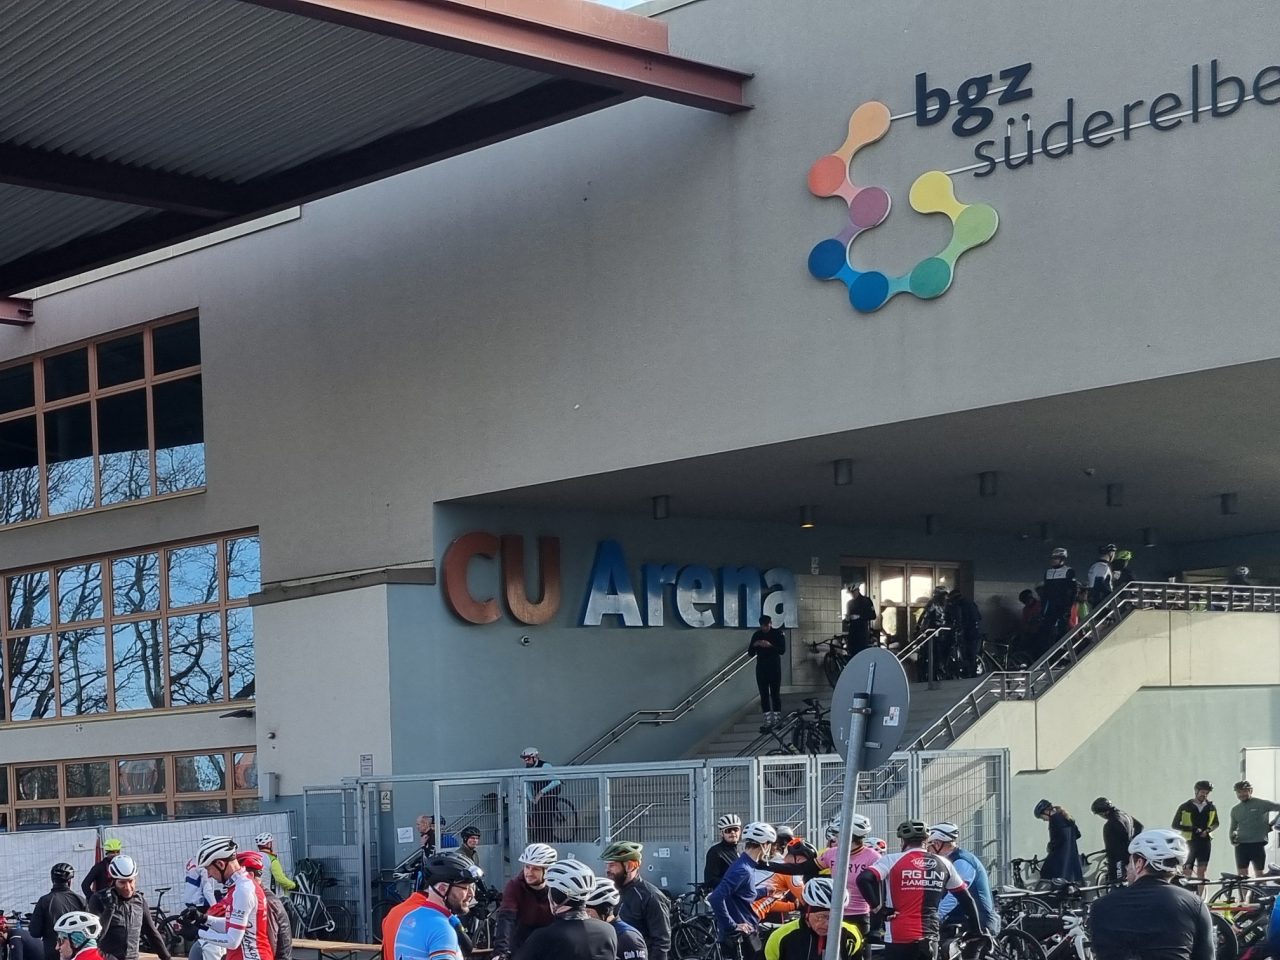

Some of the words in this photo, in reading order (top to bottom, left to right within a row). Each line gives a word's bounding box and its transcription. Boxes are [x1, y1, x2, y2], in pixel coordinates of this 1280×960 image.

[914, 62, 1033, 137] bgz
[973, 58, 1280, 178] süderelbe
[442, 531, 561, 625] CU
[580, 538, 800, 629] Arena
[901, 880, 943, 888] HAMBURG
[902, 869, 922, 879] RG
[923, 870, 945, 881] UNI
